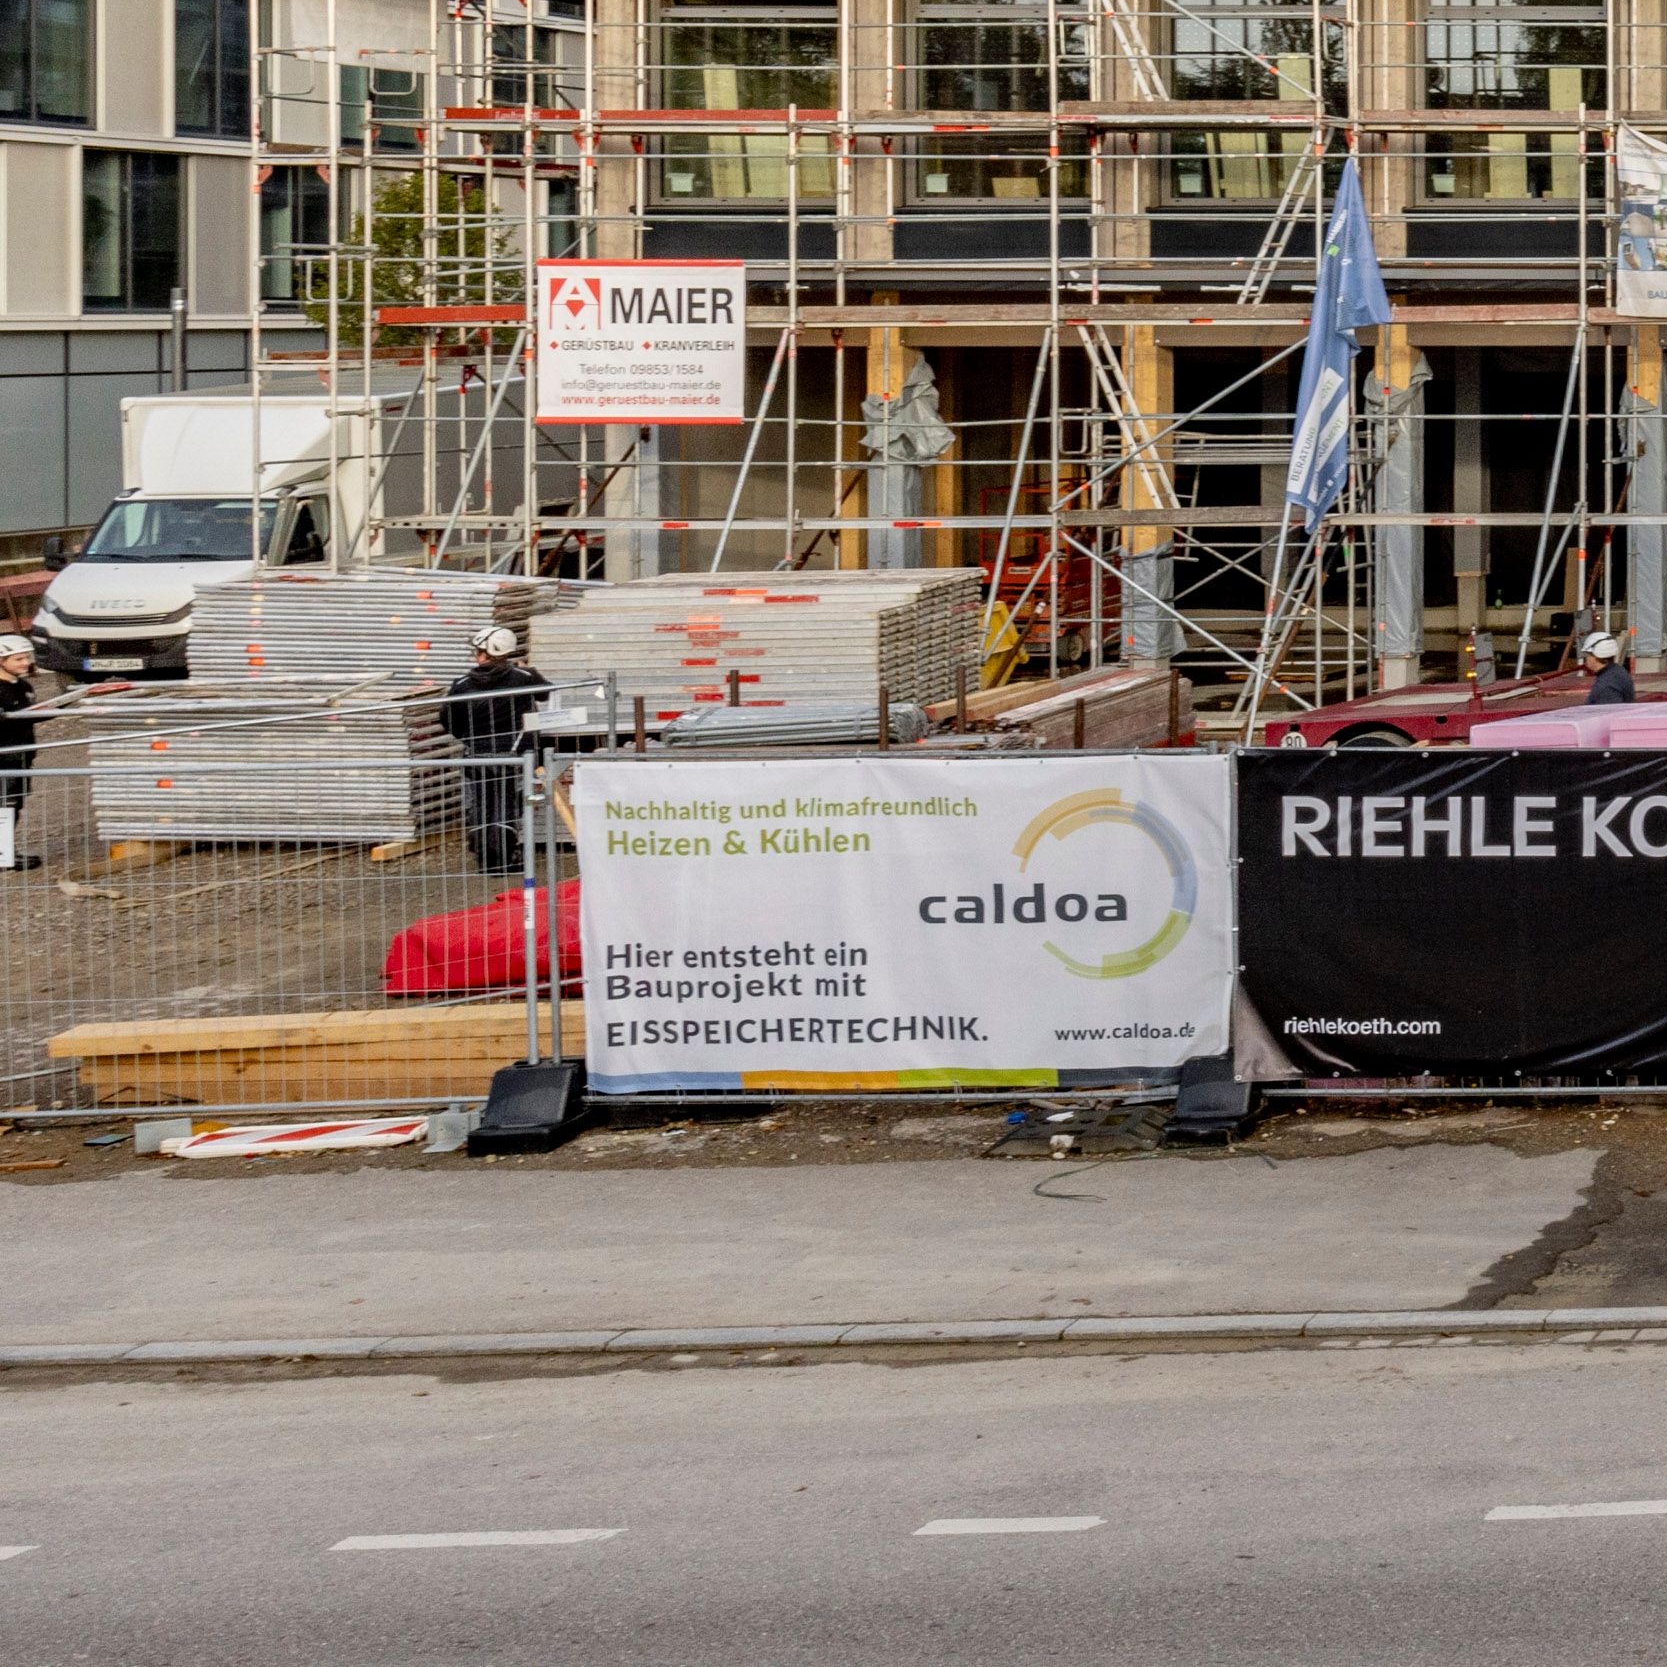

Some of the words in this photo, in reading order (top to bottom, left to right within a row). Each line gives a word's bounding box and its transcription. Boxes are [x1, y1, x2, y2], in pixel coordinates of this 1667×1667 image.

[611, 288, 733, 324] MAIER
[562, 338, 634, 351] GERÜSTBAU
[654, 340, 735, 351] KRANVERLEIH
[579, 364, 626, 375] Telefon
[630, 364, 703, 375] 09853/1584
[561, 379, 721, 392] info@geruestbau-maier.de
[562, 395, 721, 406] www.geruestbau-maier.de
[91, 599, 145, 609] IVECO
[606, 800, 731, 823] Nachhaltig
[739, 800, 786, 819] und
[795, 796, 977, 818] klimafreundlich
[1281, 795, 1556, 857] RIEHLE
[607, 829, 711, 856] Heizen
[723, 832, 746, 855] &
[760, 827, 870, 855] Kühlen
[919, 883, 1128, 925] caldoa
[607, 943, 673, 970] Hier
[683, 942, 813, 969] entsteht
[824, 944, 867, 967] ein
[607, 972, 802, 1003] Bauprojekt
[815, 974, 867, 998] mit
[607, 1016, 989, 1048] EISSPEICHERTECHNIK.
[1054, 1022, 1195, 1041] www.caldoa.de
[1284, 1017, 1441, 1036] riehlekoeth.com
